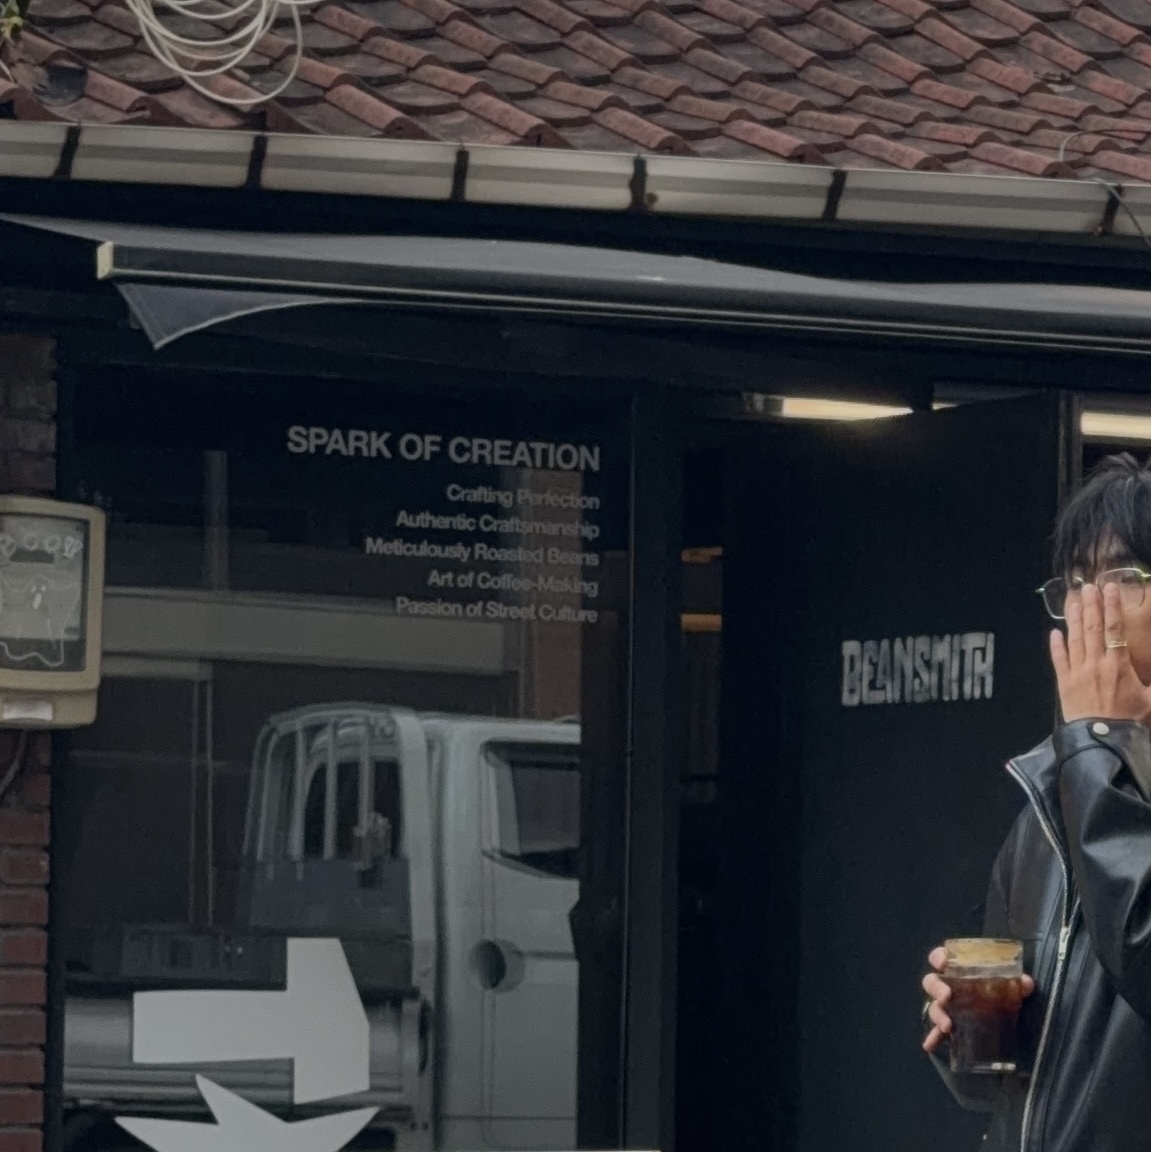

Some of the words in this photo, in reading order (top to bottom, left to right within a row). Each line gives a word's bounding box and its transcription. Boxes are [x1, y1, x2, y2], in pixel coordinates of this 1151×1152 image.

[286, 424, 392, 459] SPARK
[399, 431, 442, 462] OF
[448, 436, 601, 472] CREATION
[446, 483, 514, 508] Crafting
[516, 488, 600, 510] Perfection
[395, 510, 477, 532] Authentic
[479, 514, 600, 540] Craftsmanship
[365, 537, 472, 562] Meticulously
[474, 542, 544, 564] Roasted
[547, 546, 599, 567] Beans
[427, 570, 455, 588] Art
[457, 571, 475, 588] of
[477, 572, 599, 598] Coffee-Making
[395, 597, 463, 617] Passion
[465, 598, 483, 617] of
[485, 599, 537, 621] Street
[538, 604, 599, 624] Culture
[841, 631, 995, 707] BEANSMITH
